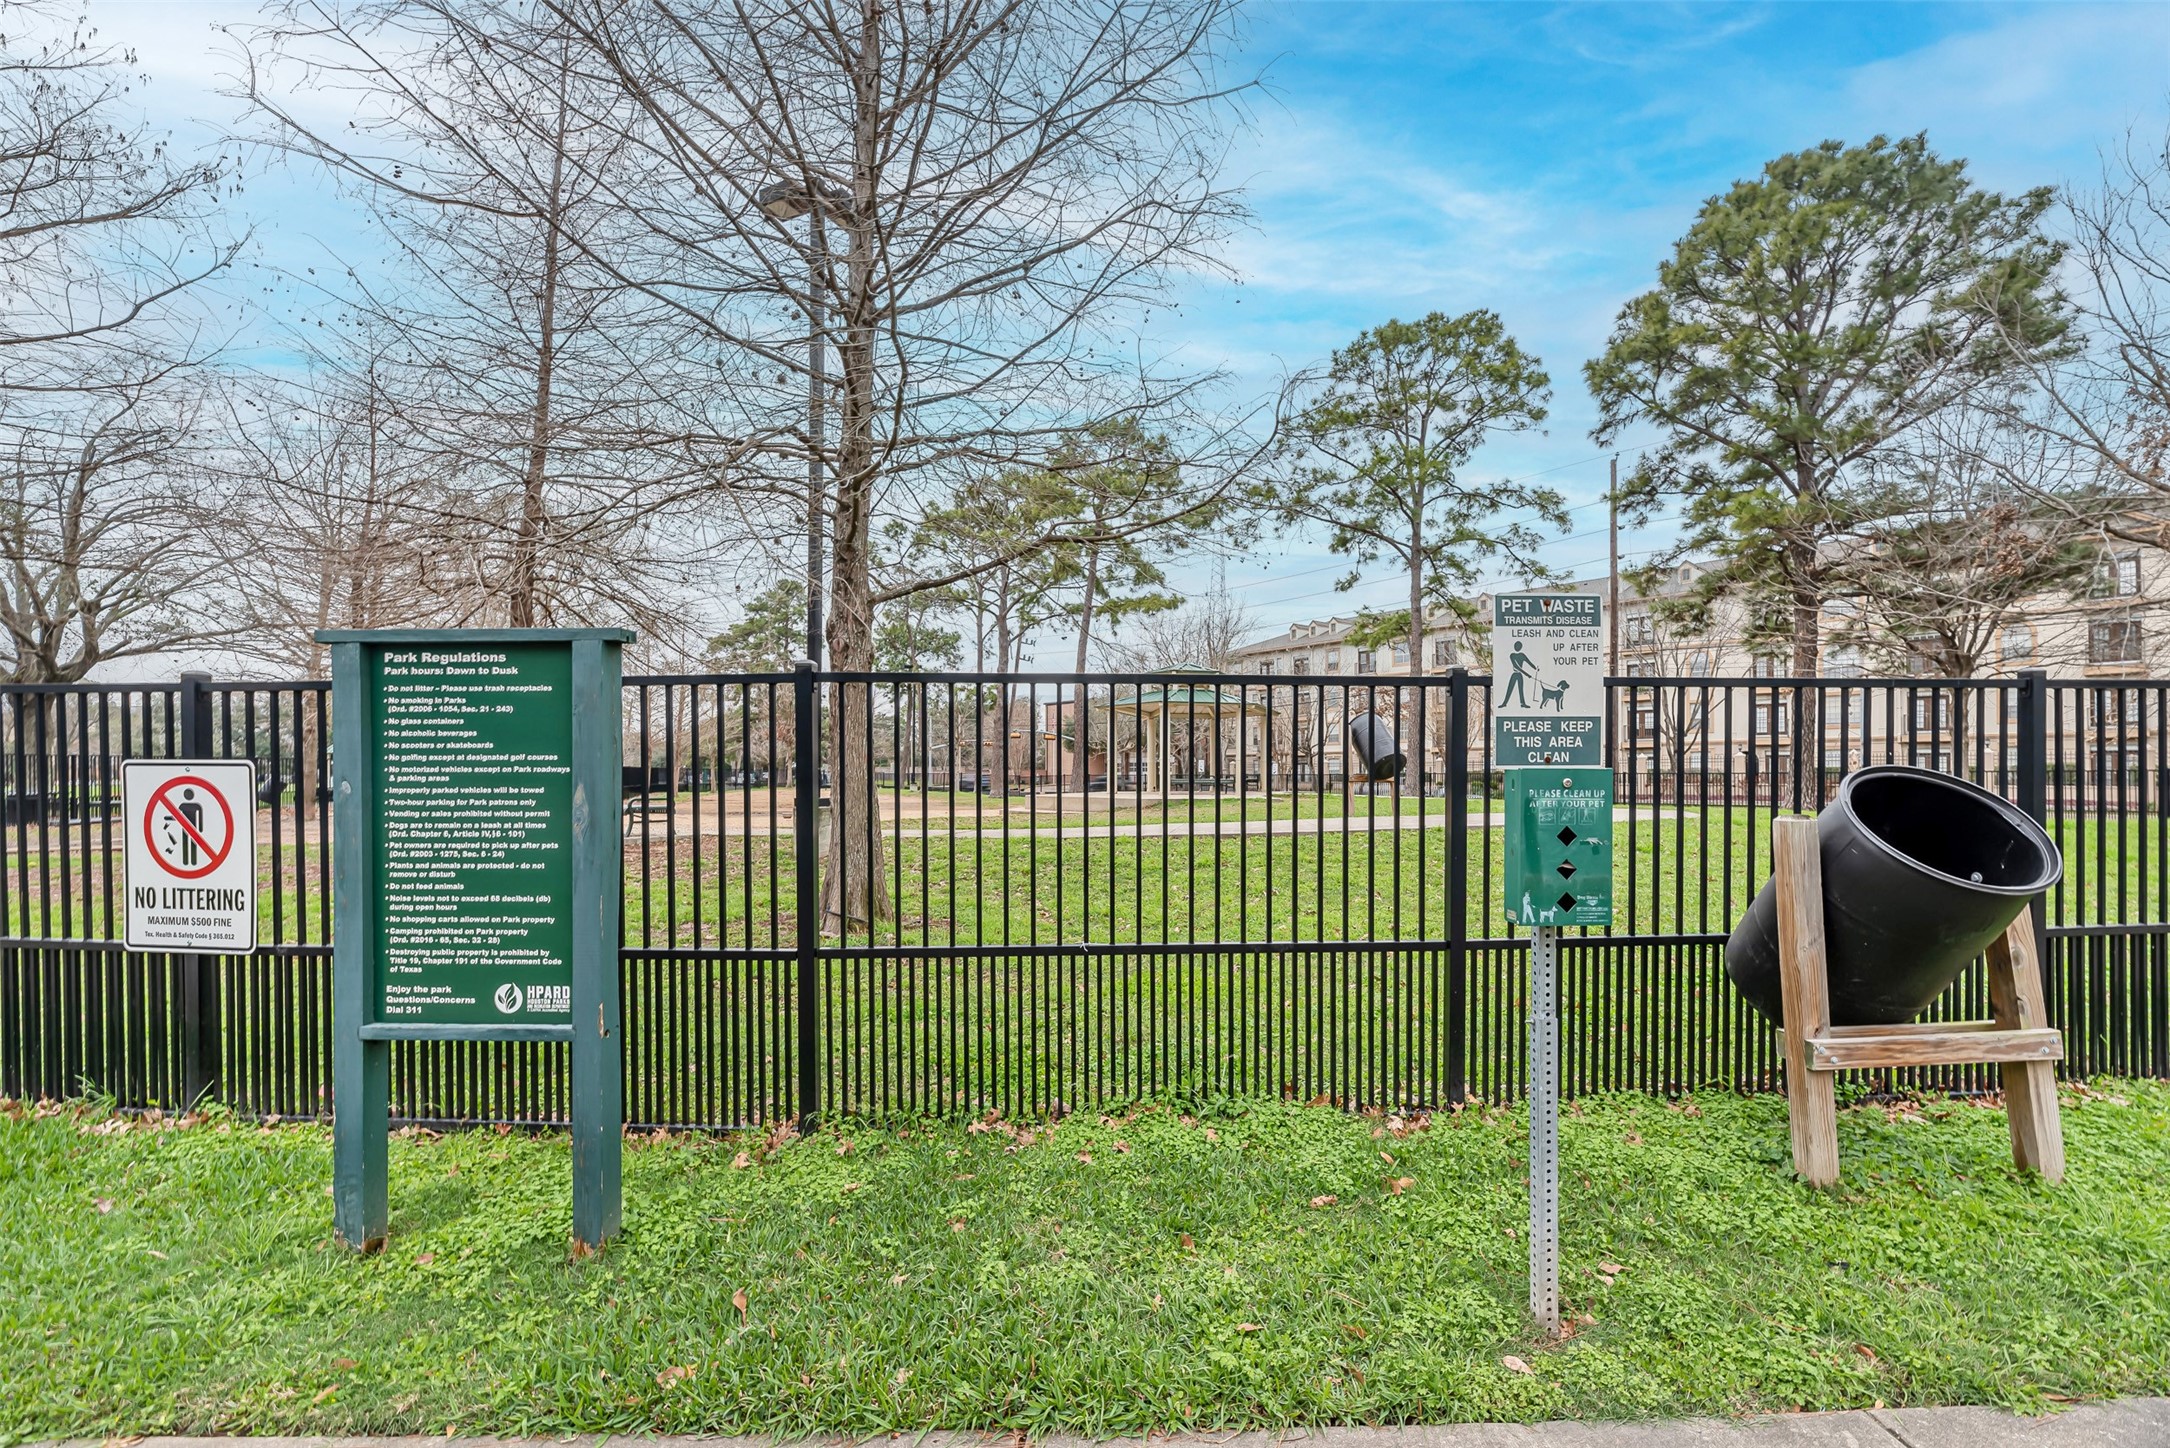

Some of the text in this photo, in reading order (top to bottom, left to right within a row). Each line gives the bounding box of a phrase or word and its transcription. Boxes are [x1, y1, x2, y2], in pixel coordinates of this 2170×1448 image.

[1502, 600, 1594, 612] PET WASTE
[1504, 616, 1553, 624] TRANSMITS
[384, 652, 506, 665] Park Regulations
[384, 667, 408, 675] Park
[410, 667, 444, 675] hours:
[446, 667, 476, 675] Dawn
[478, 667, 490, 675] to
[506, 684, 552, 693] receptacles
[400, 697, 434, 705] smoking
[400, 718, 422, 726] glass
[423, 717, 464, 725] containers
[1504, 721, 1593, 732] PLEASE KEEP
[437, 730, 477, 738] beverages
[1514, 737, 1582, 747] THIS AREA
[401, 754, 427, 762] golfing
[428, 754, 455, 762] except
[466, 754, 509, 762] designated
[510, 754, 526, 762] golf
[474, 766, 501, 774] except
[533, 766, 570, 774] roadways
[389, 774, 395, 782] &
[397, 775, 427, 783] parking
[1529, 789, 1561, 797] PLEASE
[426, 799, 455, 807] parking
[488, 799, 518, 807] patrons
[519, 799, 536, 807] only
[389, 810, 420, 818] Vending
[453, 810, 492, 818] prohibited
[524, 810, 550, 818] permit
[477, 862, 514, 870] protected
[135, 887, 245, 911] NO LITTERING
[535, 895, 551, 903] (db)
[389, 903, 414, 911] during
[148, 916, 232, 927] MAXIMUM $500 FINE
[402, 916, 437, 924] shopping
[389, 928, 423, 936] Camping
[424, 928, 463, 936] prohibited
[390, 949, 430, 957] Destroying
[457, 949, 490, 957] property
[499, 949, 539, 957] prohibited
[540, 949, 550, 957] by
[386, 985, 452, 994] Enjoy the park
[527, 986, 570, 998] HPARD
[386, 996, 476, 1004] Questions/Concerns
[406, 1006, 422, 1014] 311
